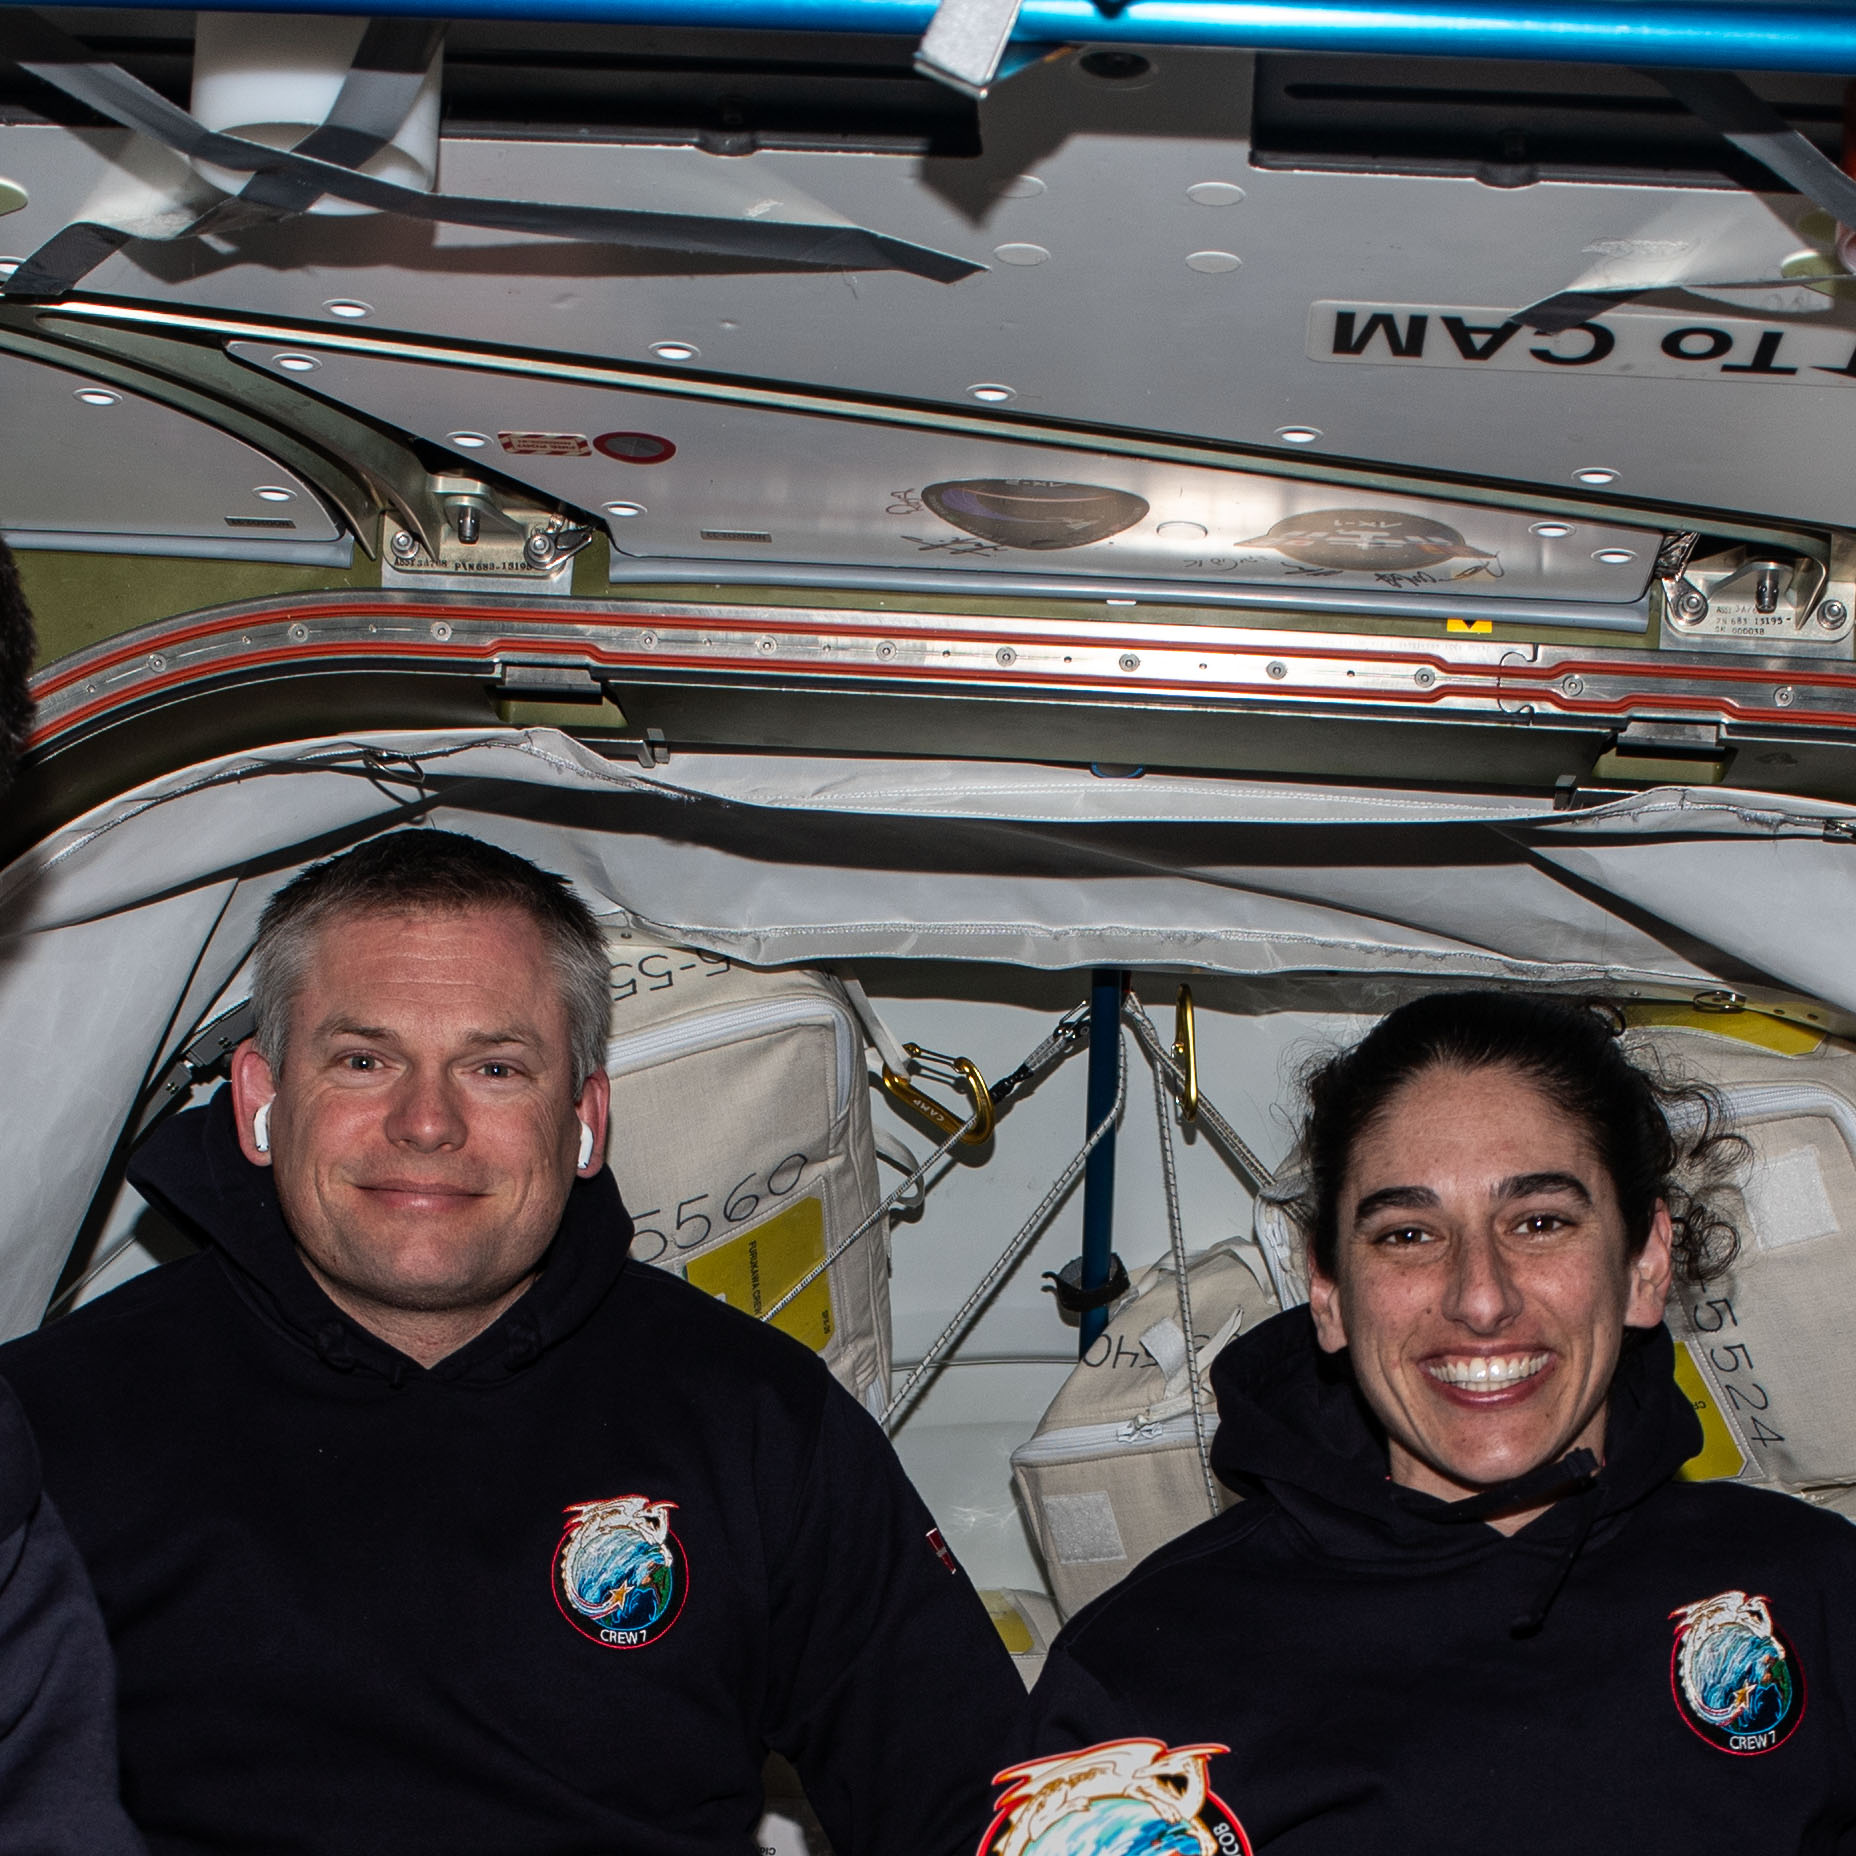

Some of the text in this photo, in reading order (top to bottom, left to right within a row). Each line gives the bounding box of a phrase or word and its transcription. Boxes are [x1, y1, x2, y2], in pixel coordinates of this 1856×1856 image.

[1331, 310, 1799, 377] To CAM
[748, 1240, 761, 1289] FURUKAWA
[599, 1628, 647, 1645] CREW 7
[1729, 1729, 1776, 1750] CREW 7
